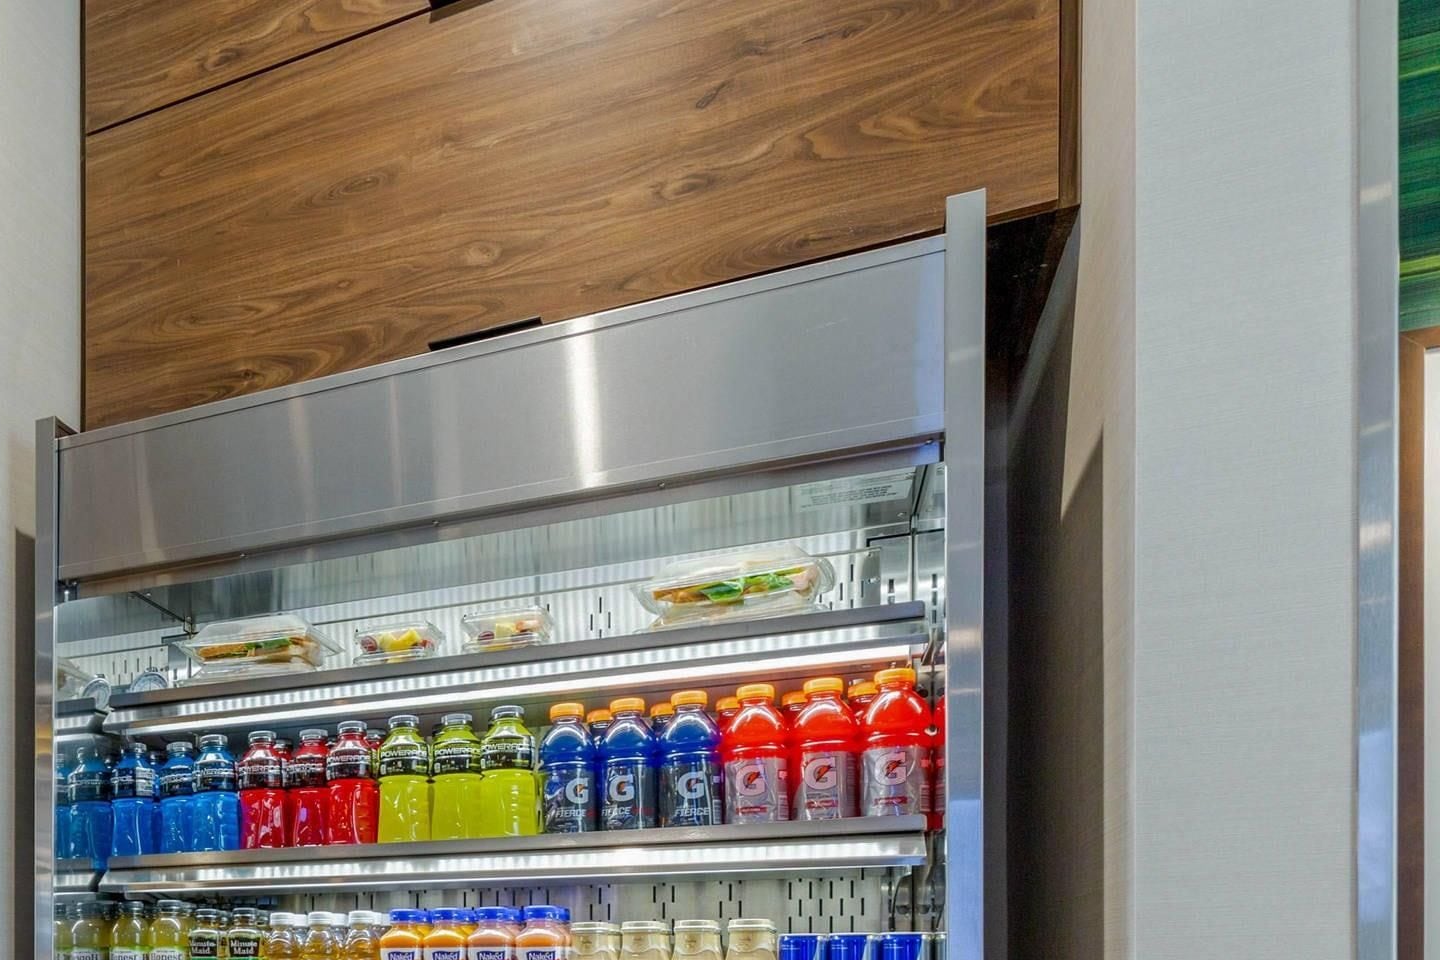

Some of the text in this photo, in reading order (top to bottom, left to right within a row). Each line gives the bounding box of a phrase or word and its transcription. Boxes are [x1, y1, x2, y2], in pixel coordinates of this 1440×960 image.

[381, 750, 427, 759] POWERADE
[435, 747, 480, 757] POWERAD
[735, 764, 767, 796] G
[804, 756, 837, 790] G
[875, 751, 907, 786] G
[566, 777, 589, 804] G
[609, 774, 635, 802] G
[677, 771, 706, 799] G
[675, 807, 711, 817] FIERCE
[230, 939, 258, 948] Minute
[234, 946, 254, 954] Maid
